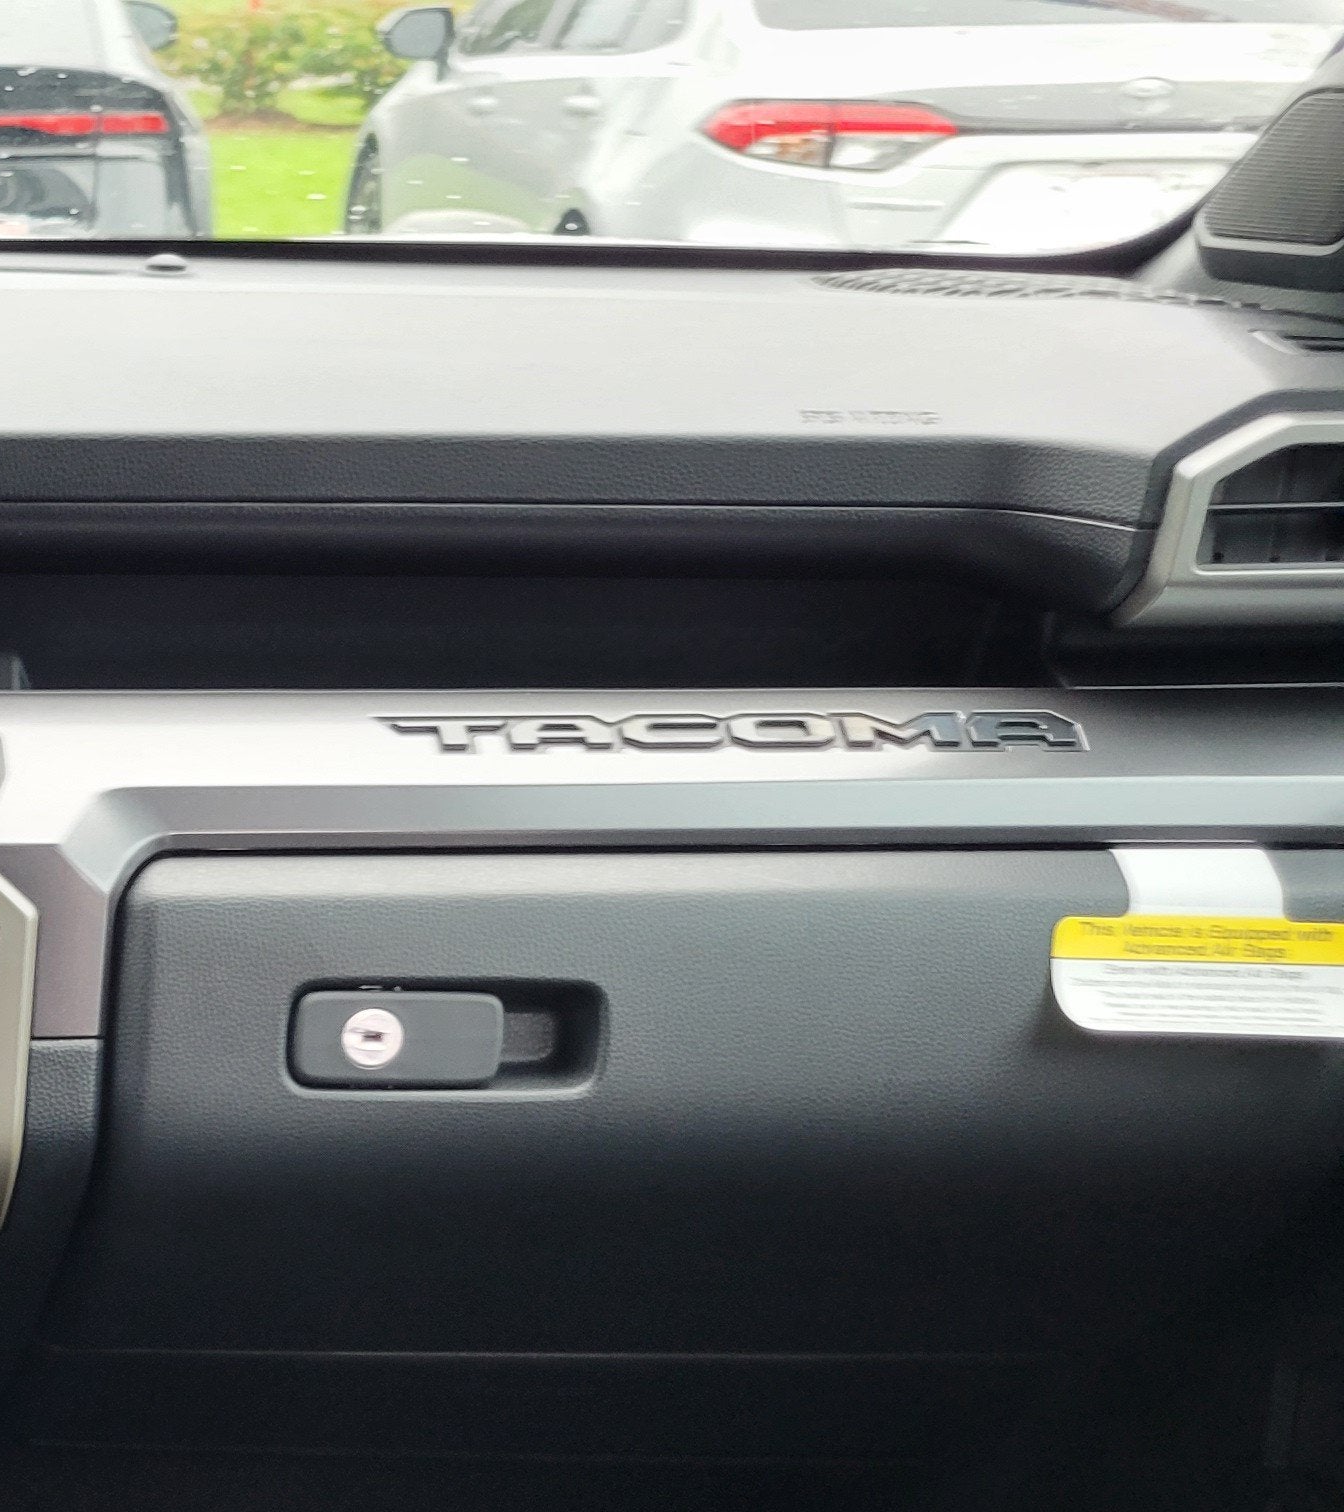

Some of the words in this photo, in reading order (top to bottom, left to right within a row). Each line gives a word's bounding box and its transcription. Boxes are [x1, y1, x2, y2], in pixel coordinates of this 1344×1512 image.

[369, 712, 1092, 752] TACOMA
[1078, 921, 1114, 937] This
[1296, 926, 1334, 942] with
